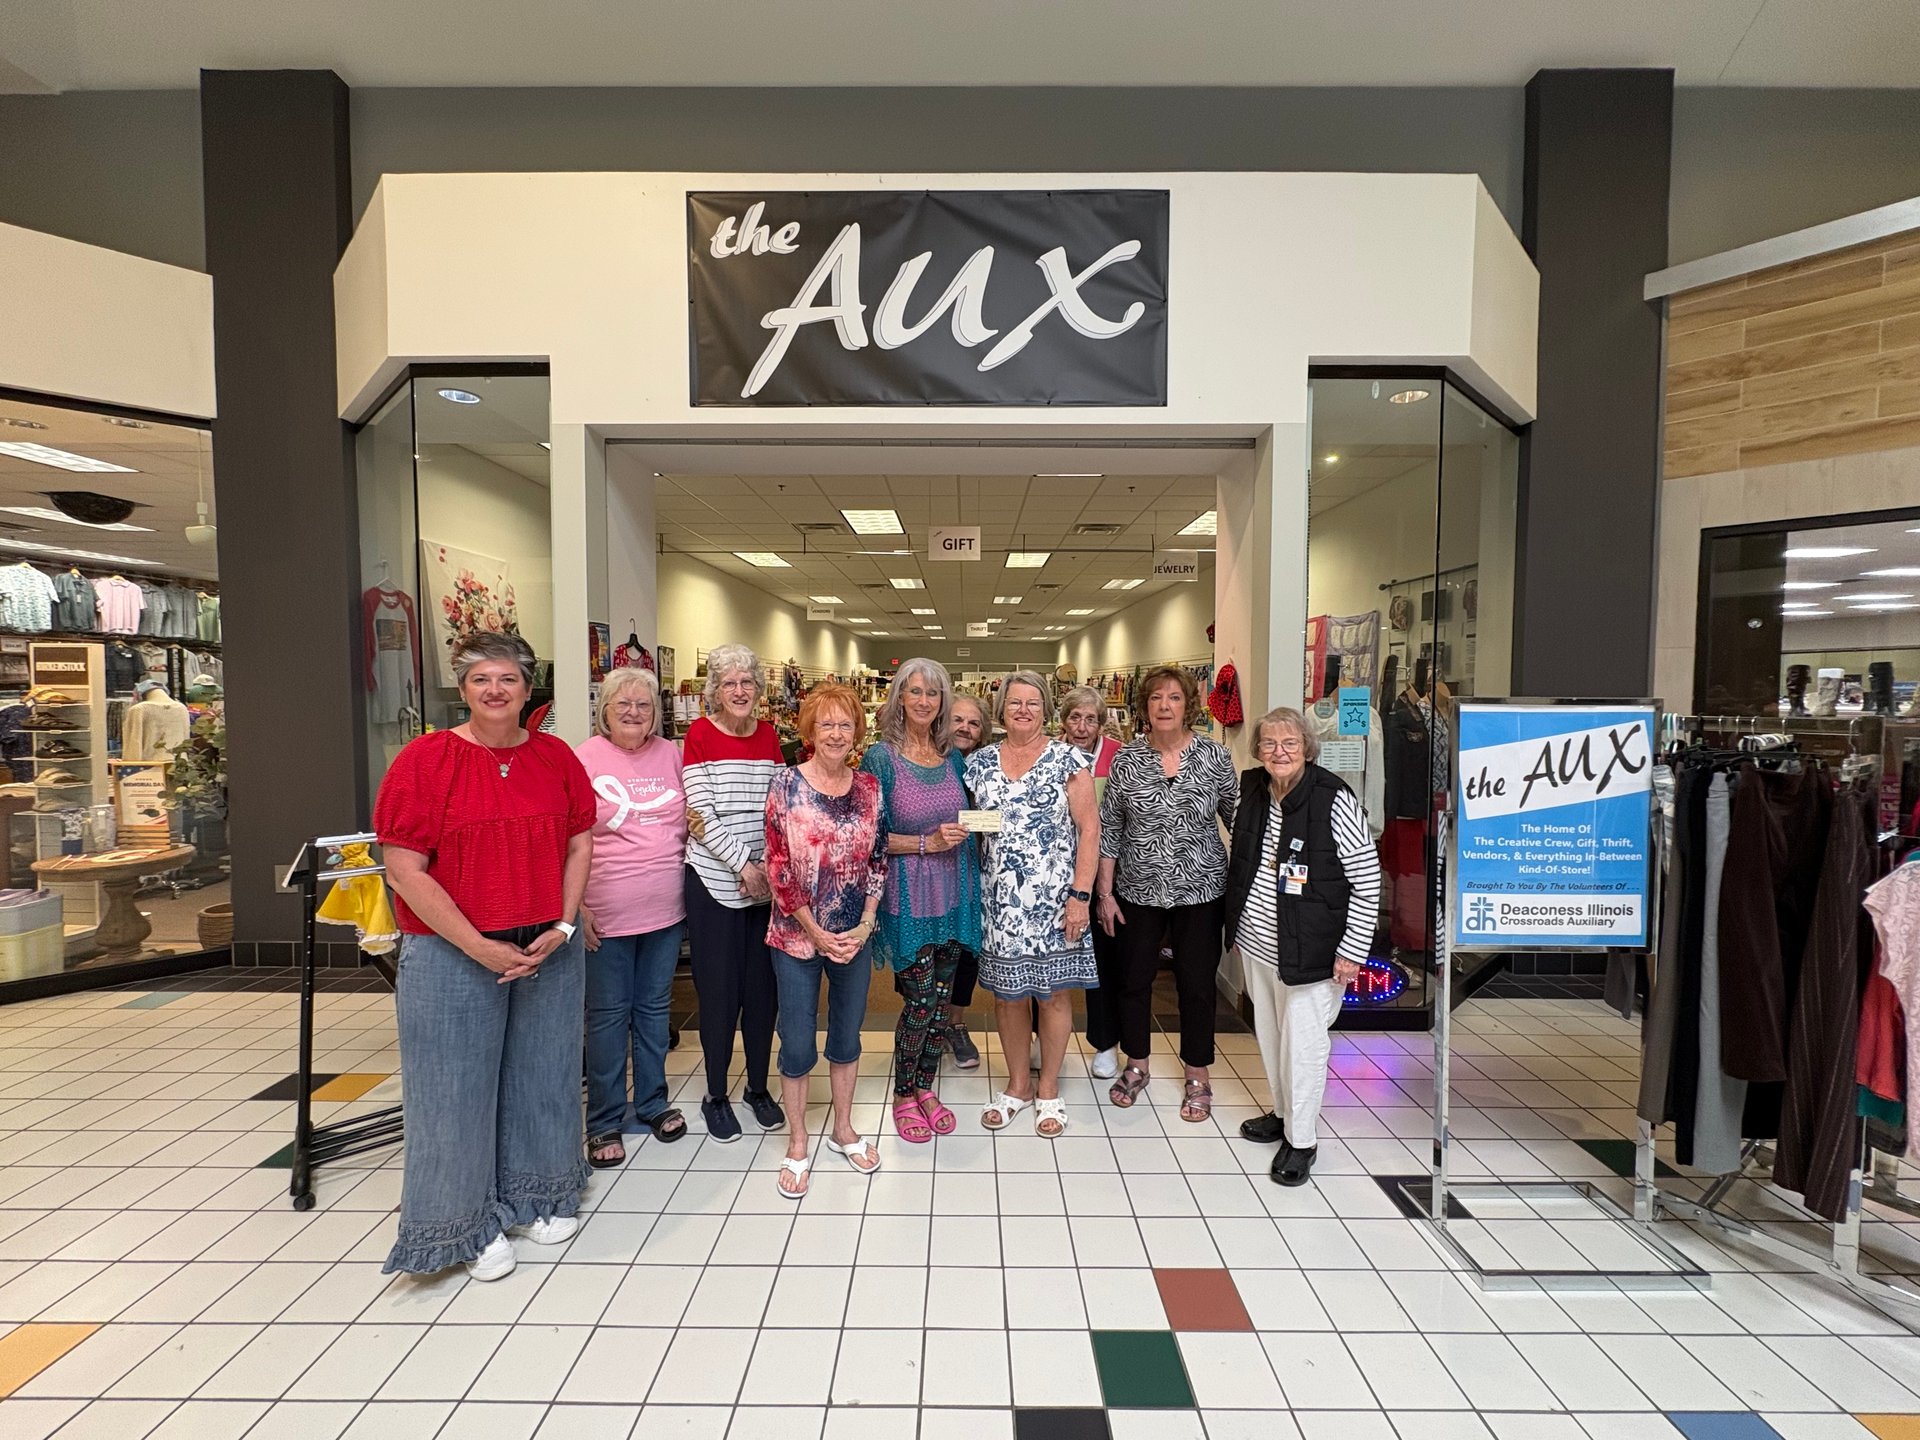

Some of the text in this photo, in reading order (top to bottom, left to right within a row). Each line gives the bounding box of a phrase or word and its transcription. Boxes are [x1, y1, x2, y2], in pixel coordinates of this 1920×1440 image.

[710, 201, 799, 258] the
[942, 538, 975, 551] GIFT
[1153, 565, 1196, 574] JEWELRY
[1465, 723, 1646, 809] the AUX
[1521, 823, 1592, 834] The Home Of
[1473, 836, 1634, 849] The Creative Crew, Gift, Thrift,
[1462, 850, 1642, 863] Vendors, & Everything In-Between
[1518, 864, 1591, 875] Kind-Of-Store!
[1466, 881, 1503, 891] Brought
[1505, 882, 1516, 890] To
[1518, 882, 1534, 890] You
[1535, 882, 1548, 892] By
[1550, 882, 1566, 890] The
[1568, 882, 1614, 891] Volunteers
[1500, 903, 1634, 917] Deaconess Illinois
[1499, 916, 1616, 929] Crossroads Auxiliary
